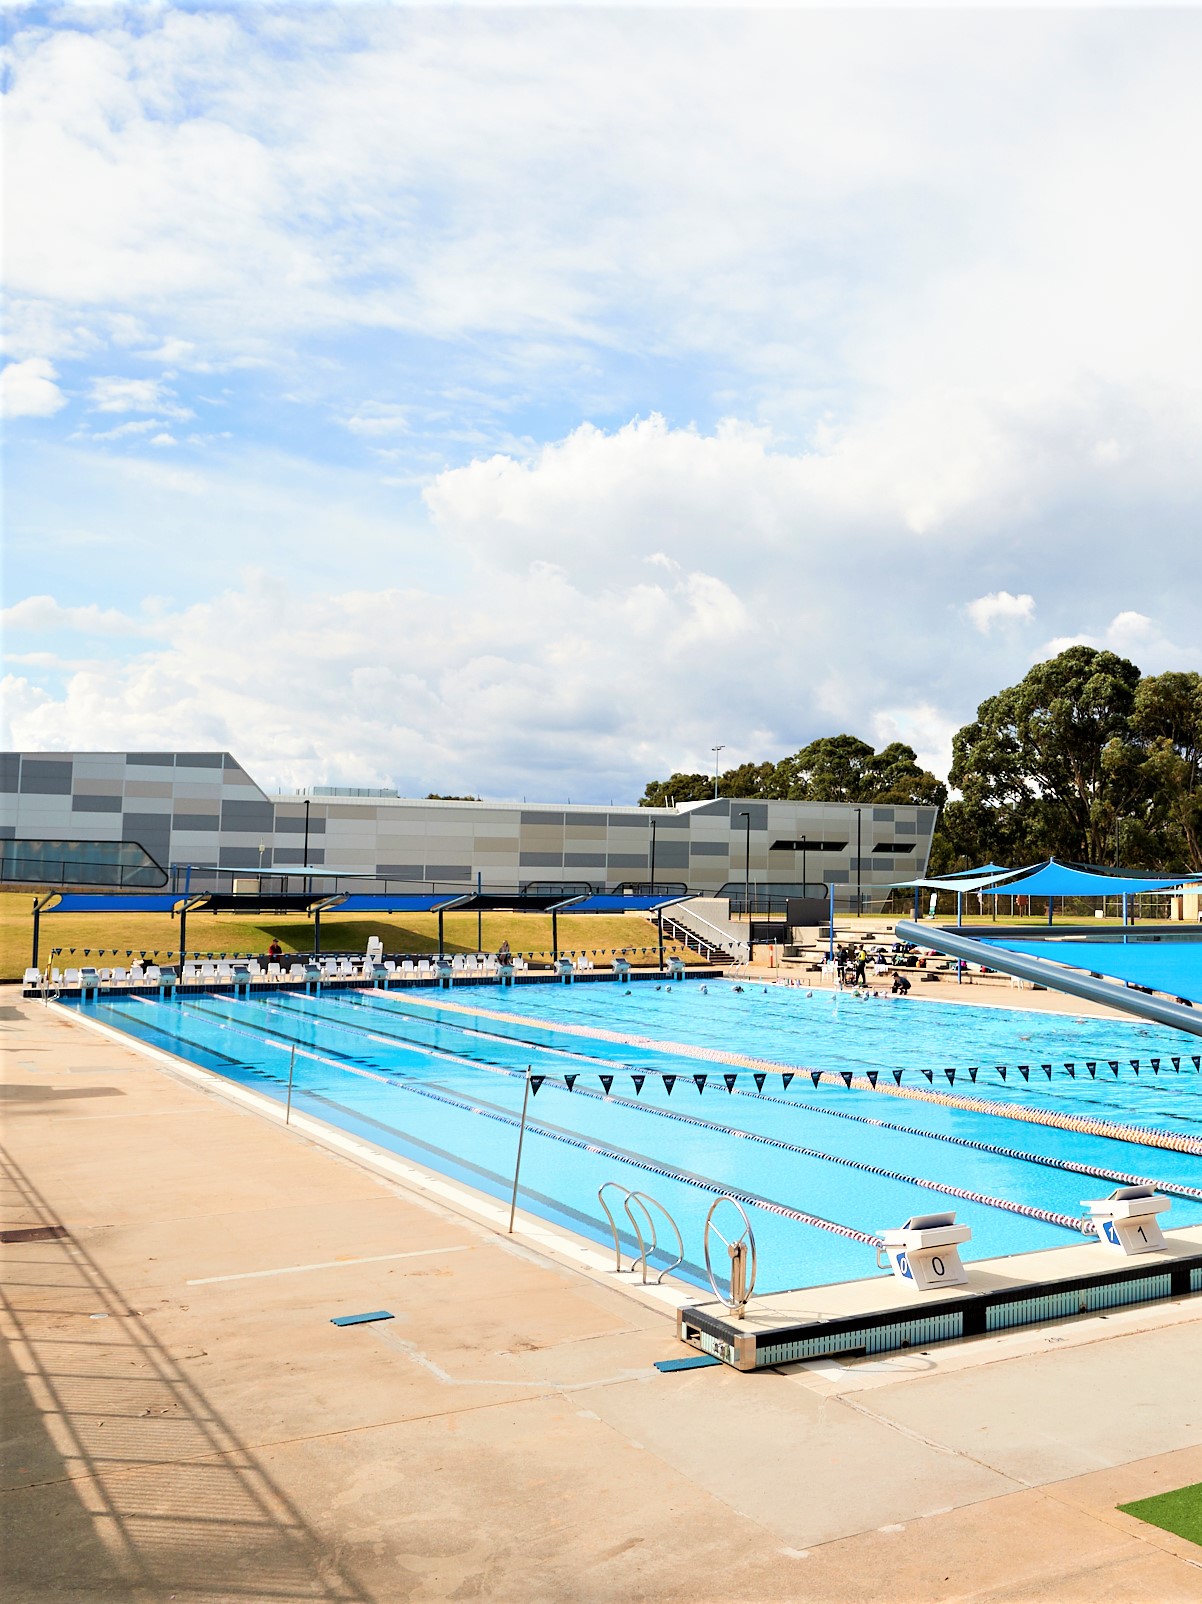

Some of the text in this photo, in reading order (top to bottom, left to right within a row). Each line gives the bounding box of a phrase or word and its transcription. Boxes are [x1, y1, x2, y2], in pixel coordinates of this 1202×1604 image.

[1108, 1226, 1115, 1241] 1
[1137, 1225, 1148, 1243] 1
[900, 1257, 908, 1275] 0
[931, 1256, 945, 1276] 0
